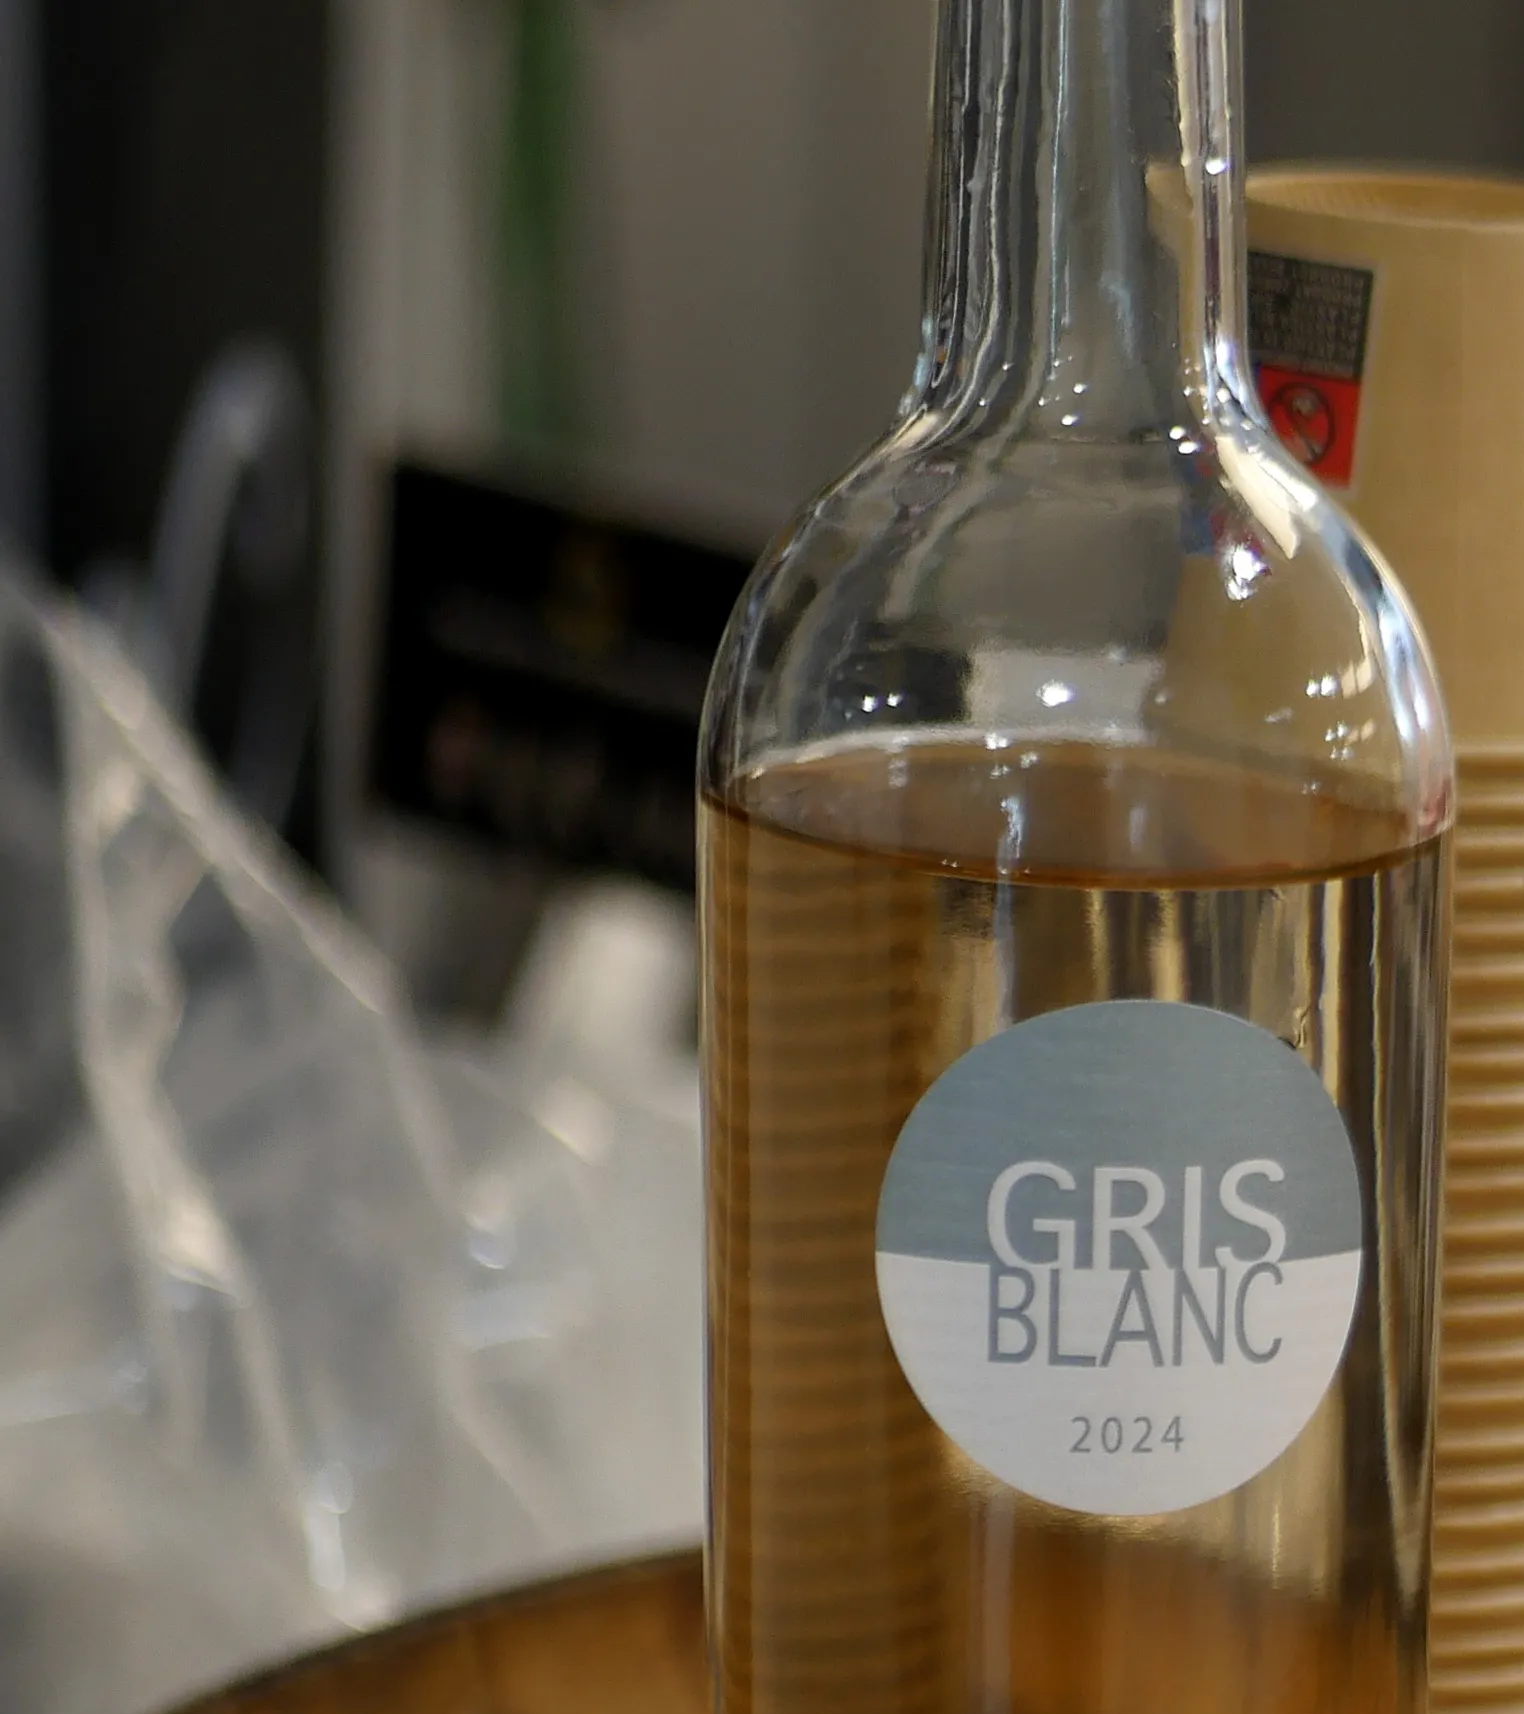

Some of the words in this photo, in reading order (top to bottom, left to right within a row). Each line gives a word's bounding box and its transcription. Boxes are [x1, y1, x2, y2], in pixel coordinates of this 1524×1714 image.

[986, 1159, 1287, 1271] GRIS
[986, 1261, 1284, 1368] BLANC
[1069, 1415, 1186, 1455] 2024
